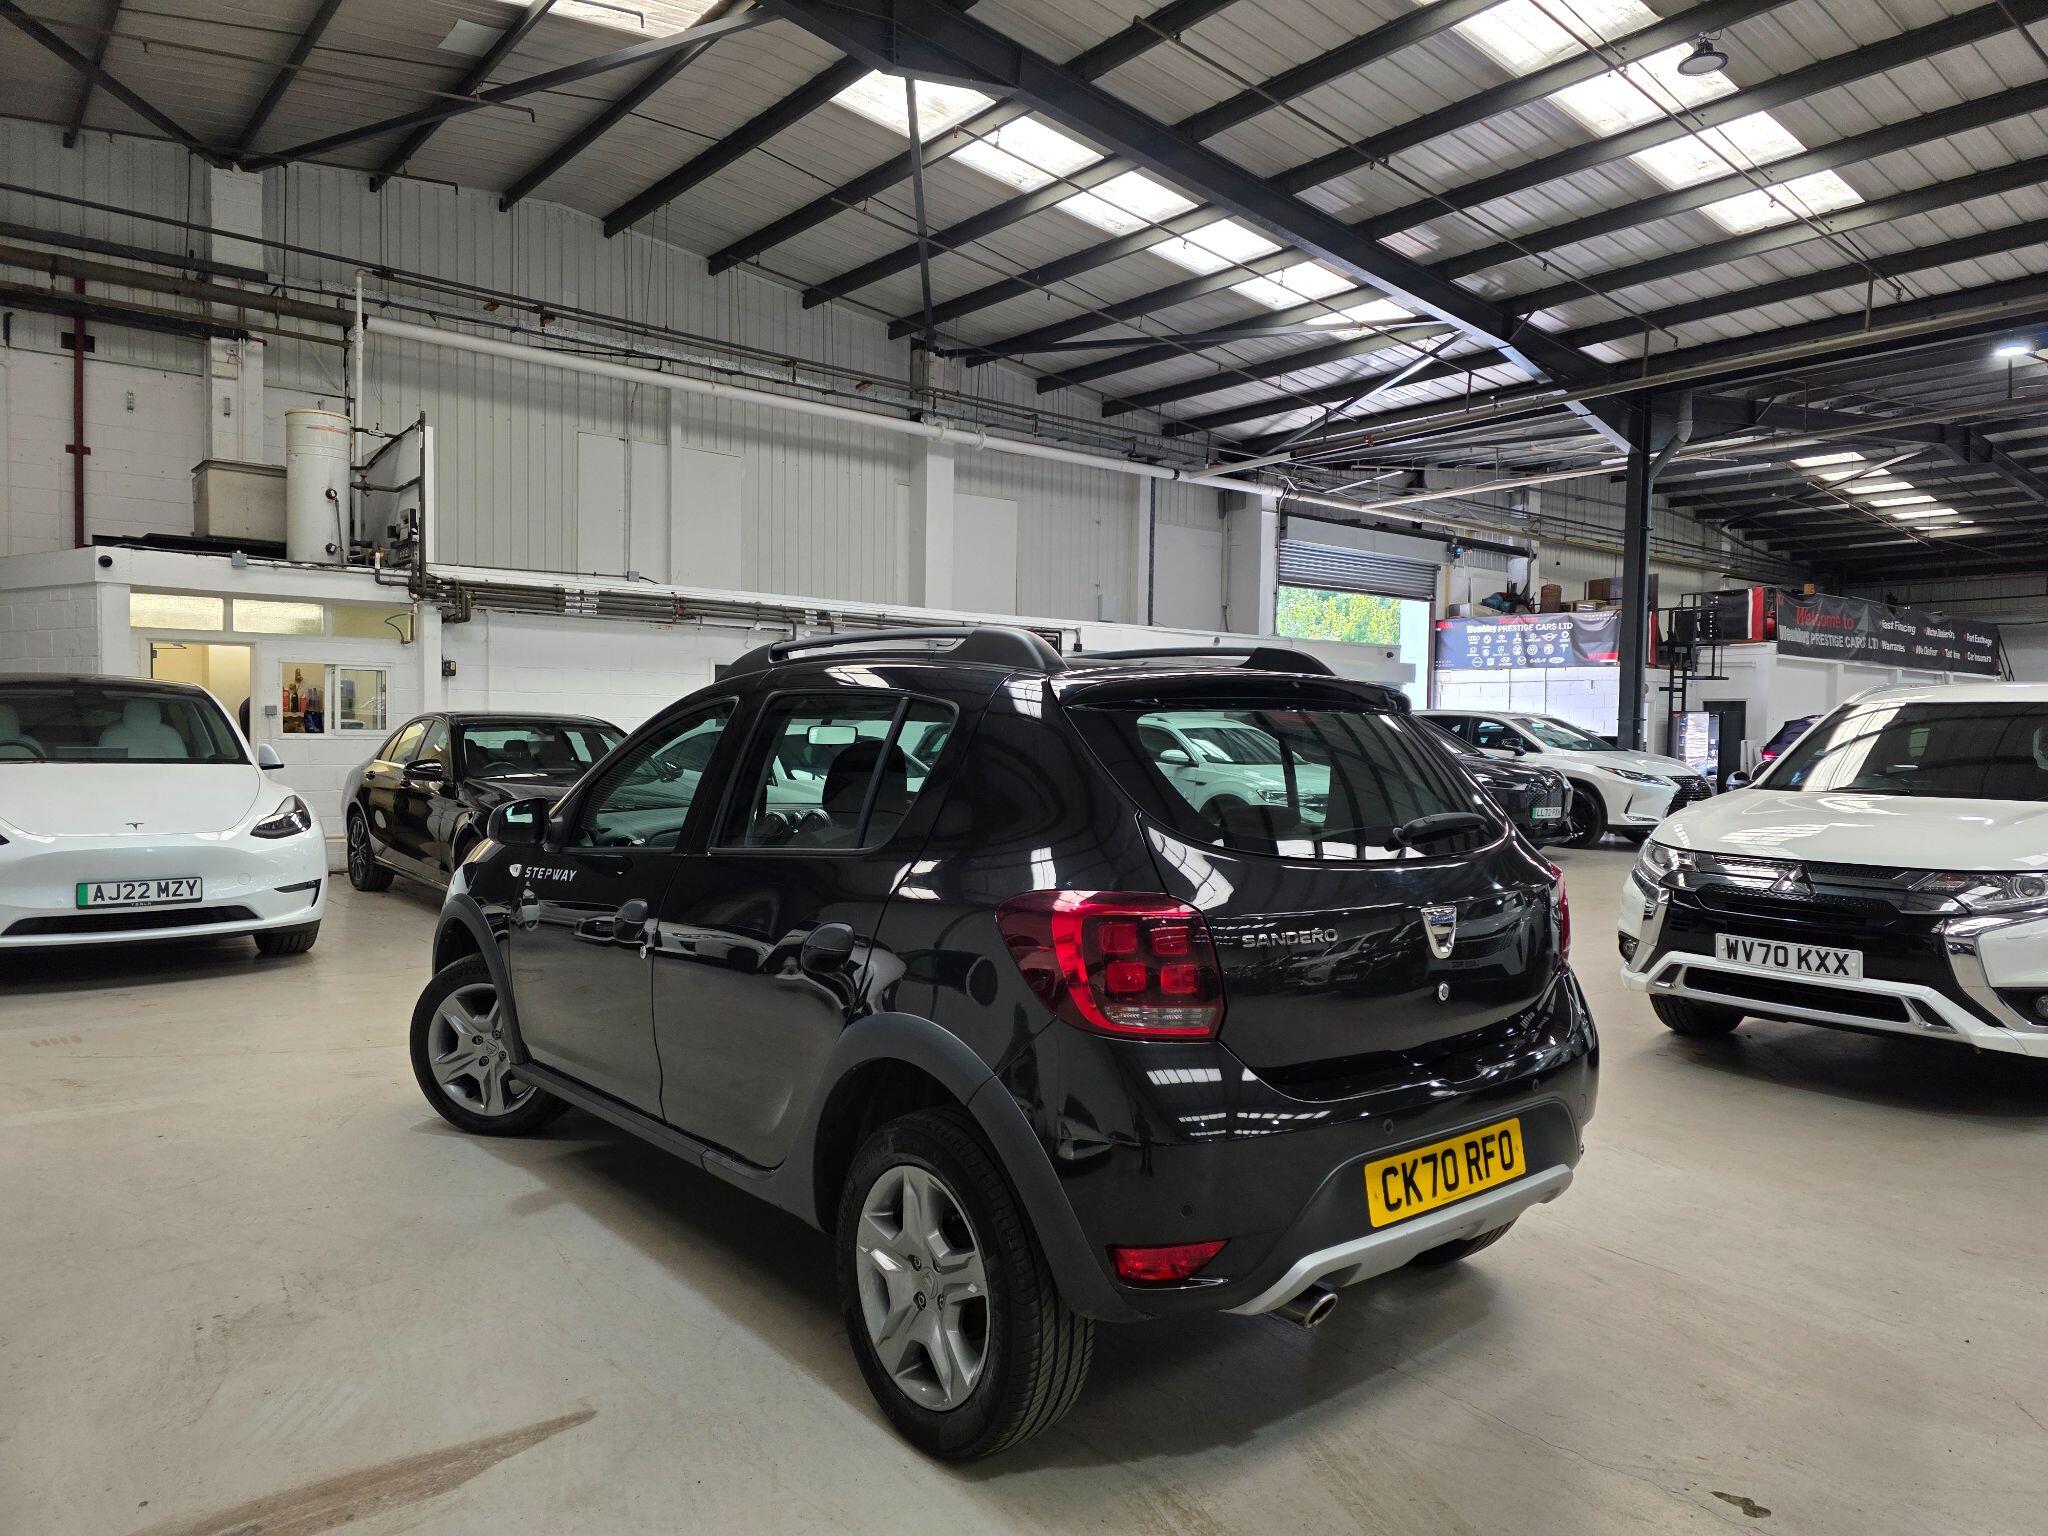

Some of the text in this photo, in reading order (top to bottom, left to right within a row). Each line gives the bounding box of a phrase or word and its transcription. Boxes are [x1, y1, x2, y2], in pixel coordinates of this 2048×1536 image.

[1498, 624, 1534, 633] PRESTIGE
[1536, 623, 1557, 631] CARS
[1558, 622, 1573, 630] LTD
[1843, 613, 1854, 630] to
[1811, 632, 1844, 648] PRESTIGE
[1845, 636, 1866, 649] CARS
[524, 866, 578, 882] STEPWAY
[93, 879, 198, 902] AJ22 MZY
[1241, 927, 1339, 948] SANDERO
[1725, 938, 1850, 976] WV70 KXX
[1381, 1129, 1515, 1212] CK70 RFO
